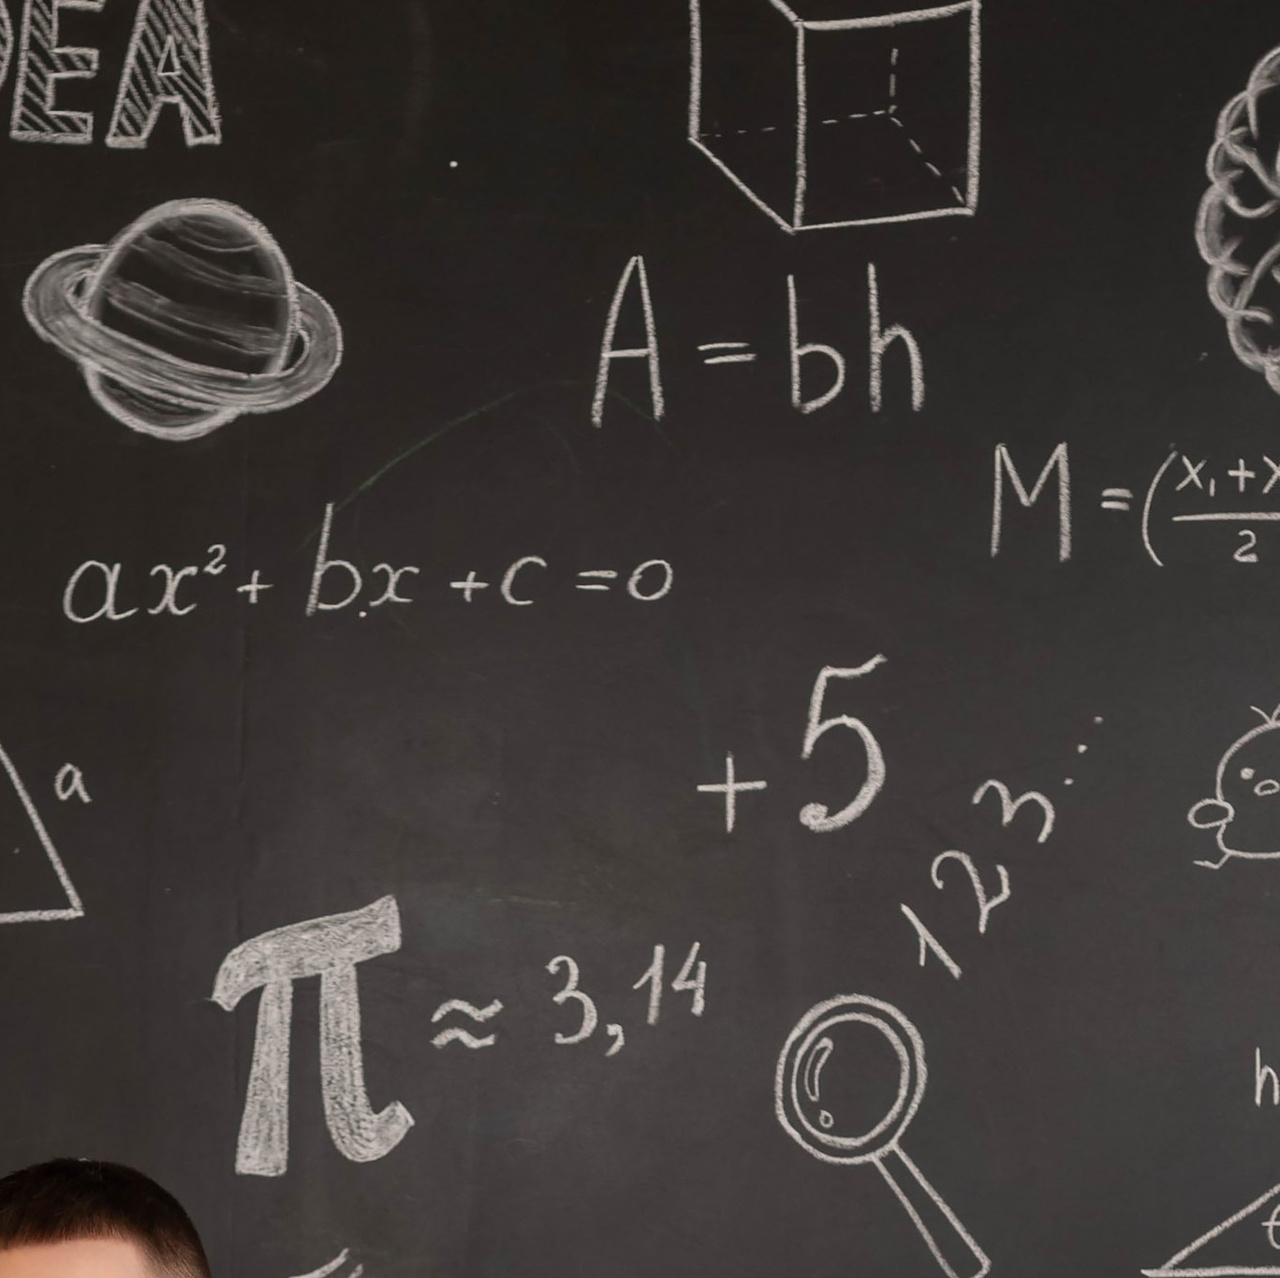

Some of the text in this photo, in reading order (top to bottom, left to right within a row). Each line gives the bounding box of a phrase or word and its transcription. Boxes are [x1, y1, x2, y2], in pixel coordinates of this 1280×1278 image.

[593, 256, 663, 424] A
[992, 443, 1070, 560] M
[55, 764, 90, 802] a
[211, 895, 415, 1177] π
[546, 942, 706, 1056] 3,14
